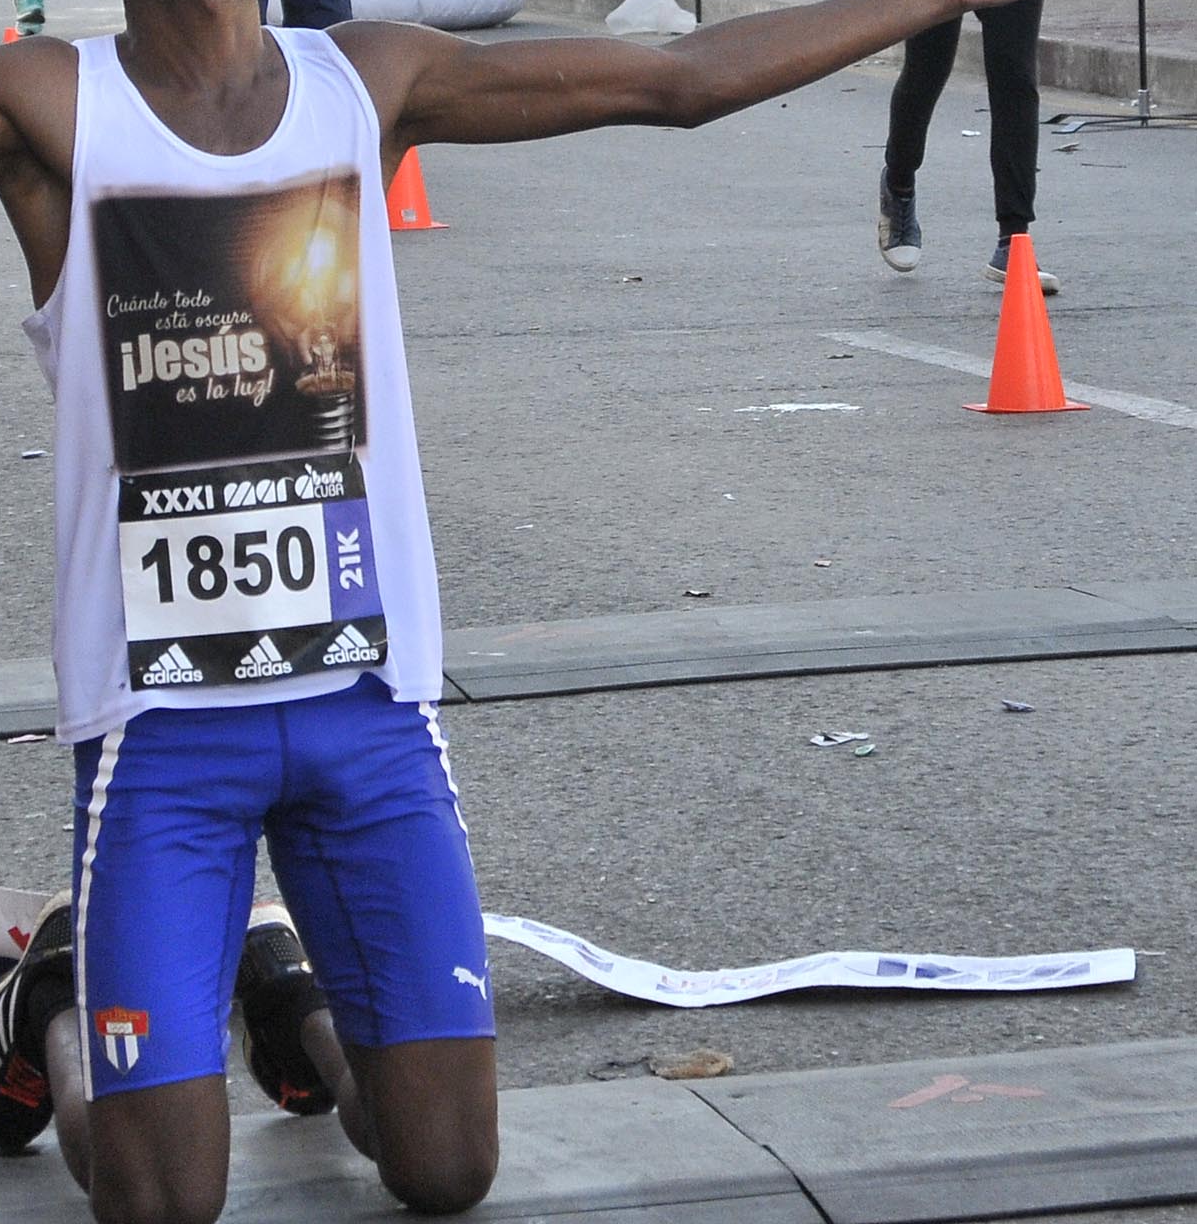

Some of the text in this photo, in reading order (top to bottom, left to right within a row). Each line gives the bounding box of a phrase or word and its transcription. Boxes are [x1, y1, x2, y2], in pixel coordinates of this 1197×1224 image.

[107, 289, 214, 318] Cuándo todo
[155, 311, 190, 330] está
[121, 325, 267, 392] ¡Jesús
[176, 368, 274, 407] es la luz!
[141, 484, 215, 515] XXXI
[313, 484, 345, 498] CUBA
[141, 526, 315, 604] 1850
[336, 527, 364, 590] 21K
[142, 647, 380, 686] adidas adidas adidas
